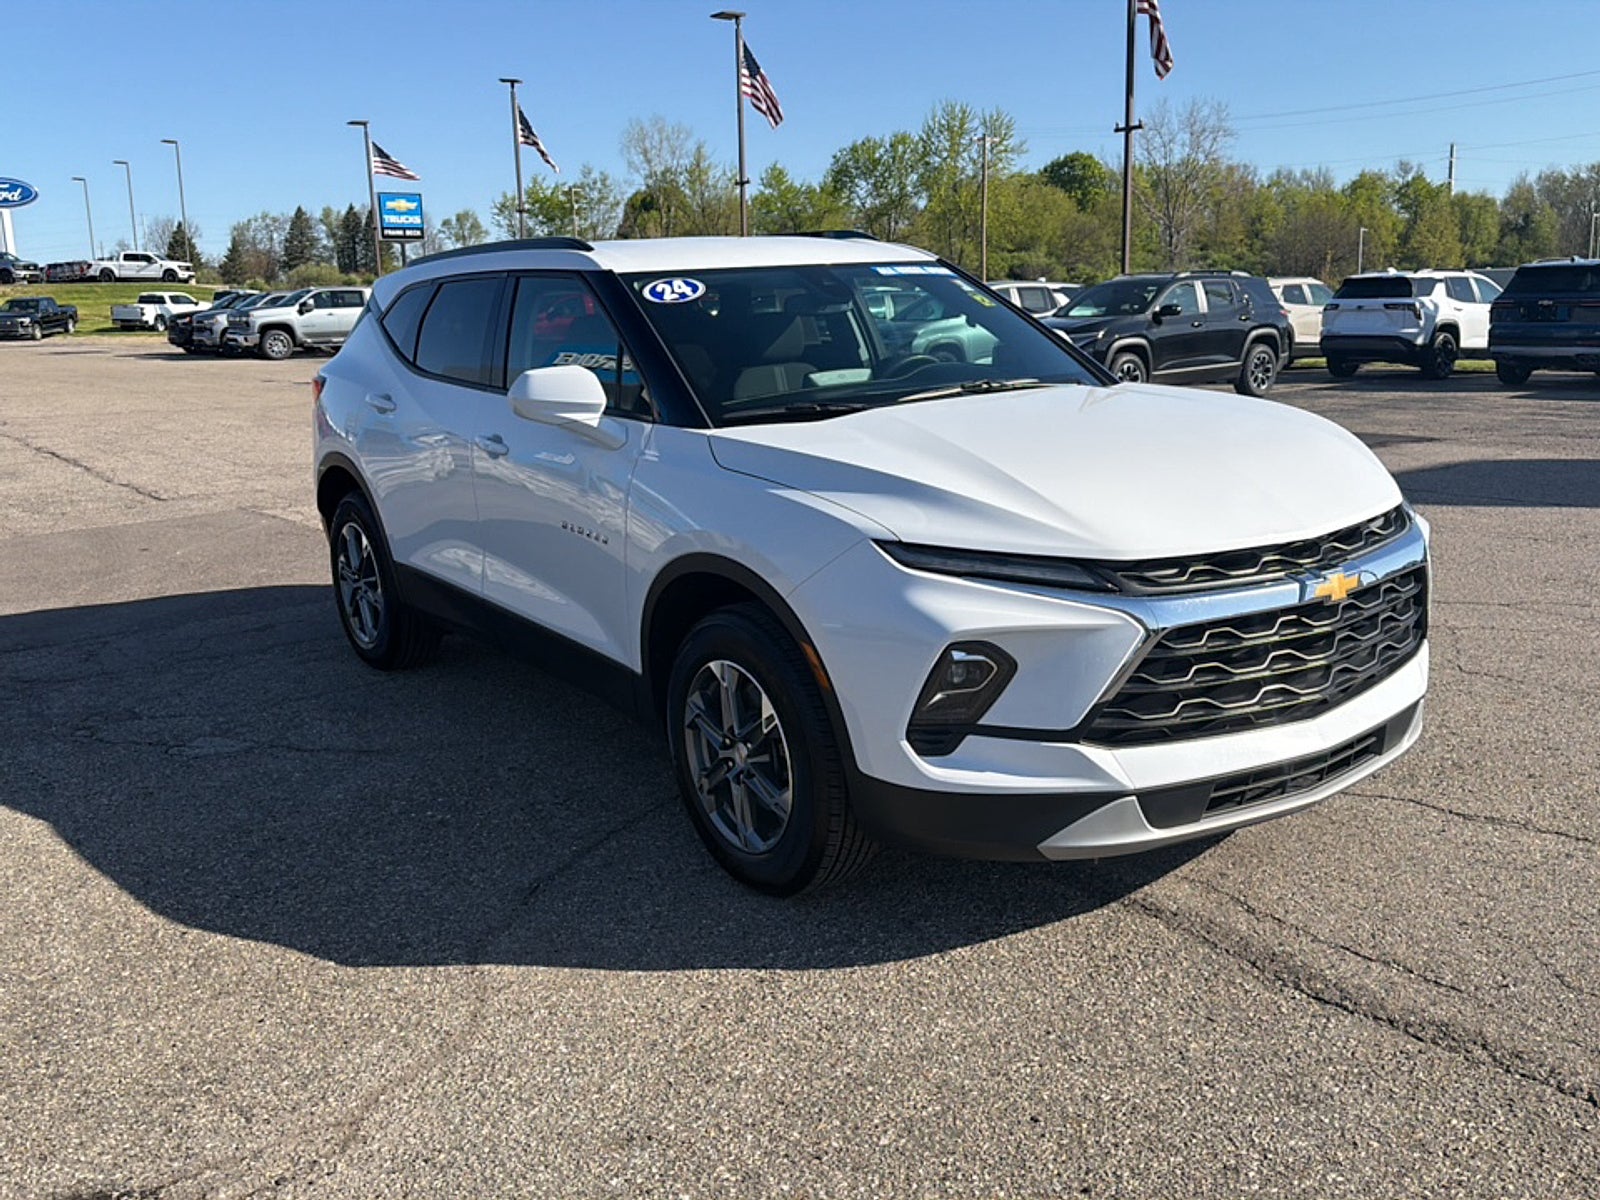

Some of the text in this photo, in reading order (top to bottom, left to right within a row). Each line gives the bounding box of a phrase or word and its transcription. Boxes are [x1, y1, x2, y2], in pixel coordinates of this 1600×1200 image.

[383, 215, 421, 224] TRUCKS
[655, 279, 694, 302] 24
[561, 520, 609, 545] BLAZER
